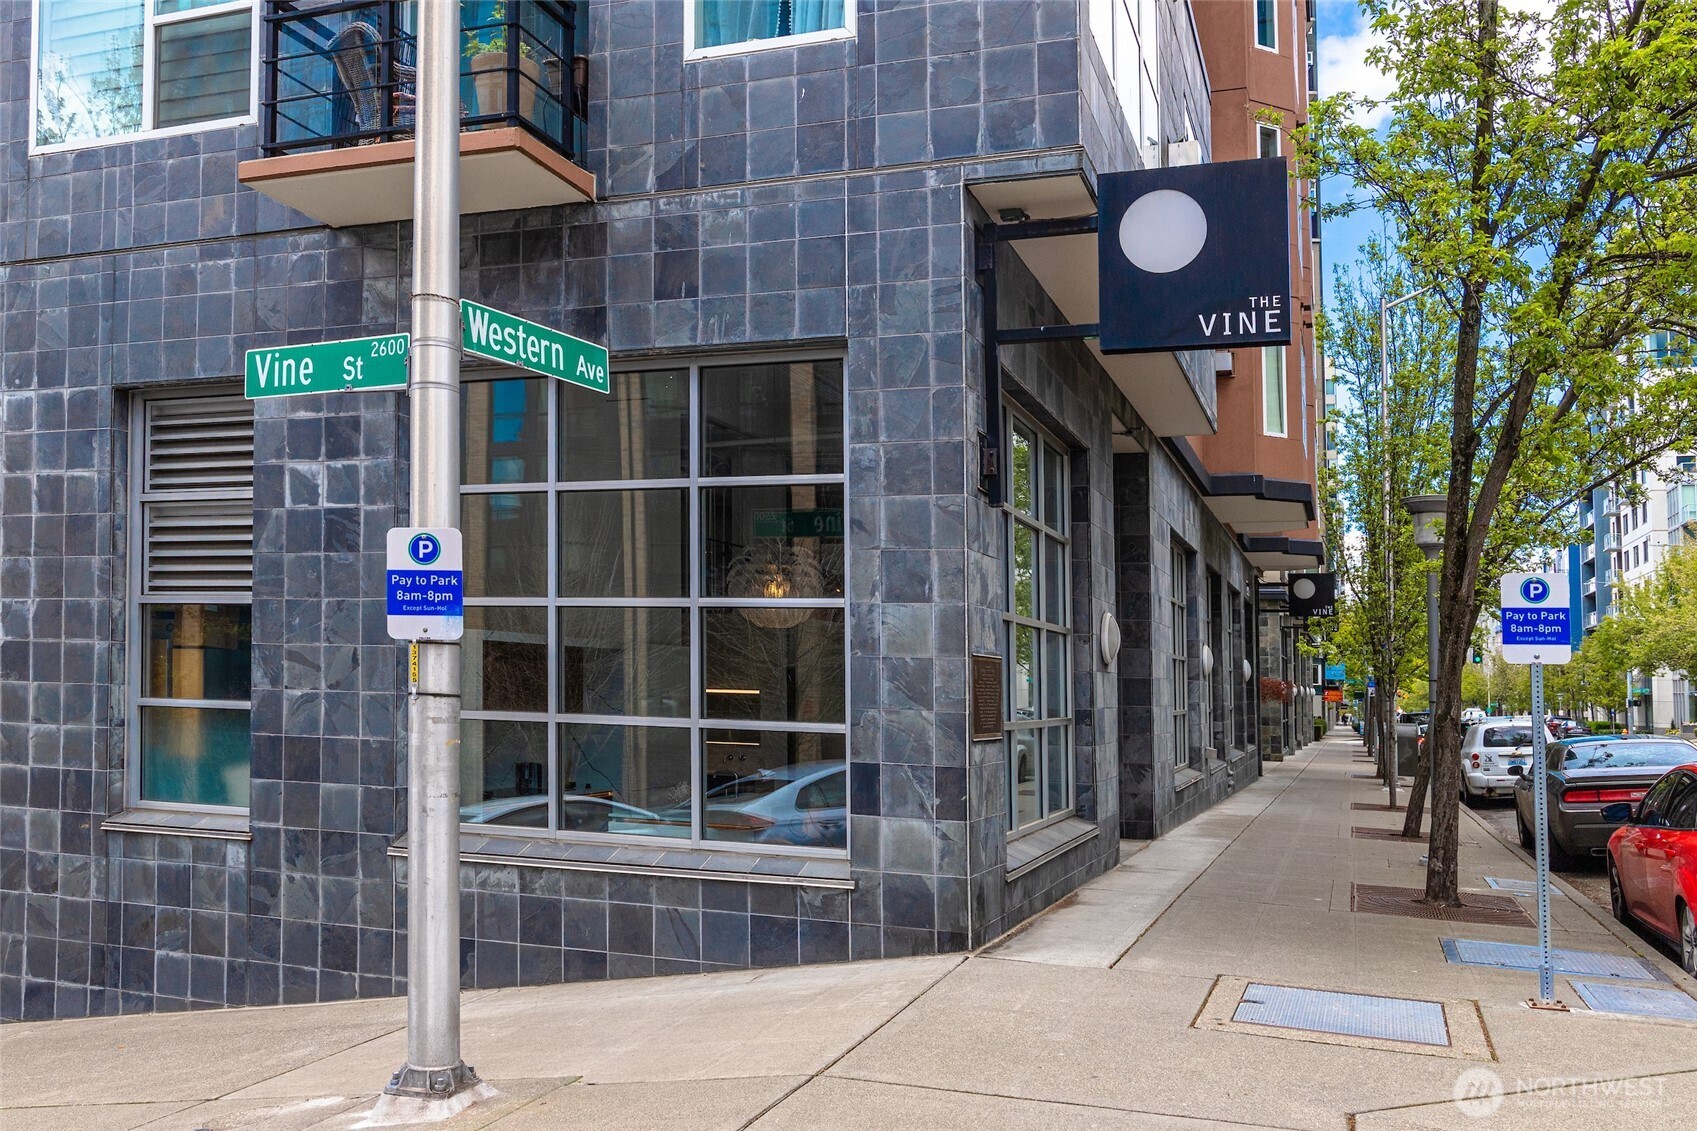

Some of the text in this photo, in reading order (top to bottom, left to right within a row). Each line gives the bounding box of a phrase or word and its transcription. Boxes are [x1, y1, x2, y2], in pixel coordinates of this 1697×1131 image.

[1248, 295, 1281, 308] THE
[1198, 309, 1282, 337] VINE
[370, 338, 406, 359] 2600
[467, 306, 605, 384] Western Ave
[255, 353, 364, 388] Vine St
[391, 575, 458, 587] Pay to Park
[396, 591, 453, 603] 8am-8pm
[402, 604, 422, 612] Except
[1506, 611, 1566, 622] Pay to Park
[1510, 624, 1562, 634] 8am-8pm
